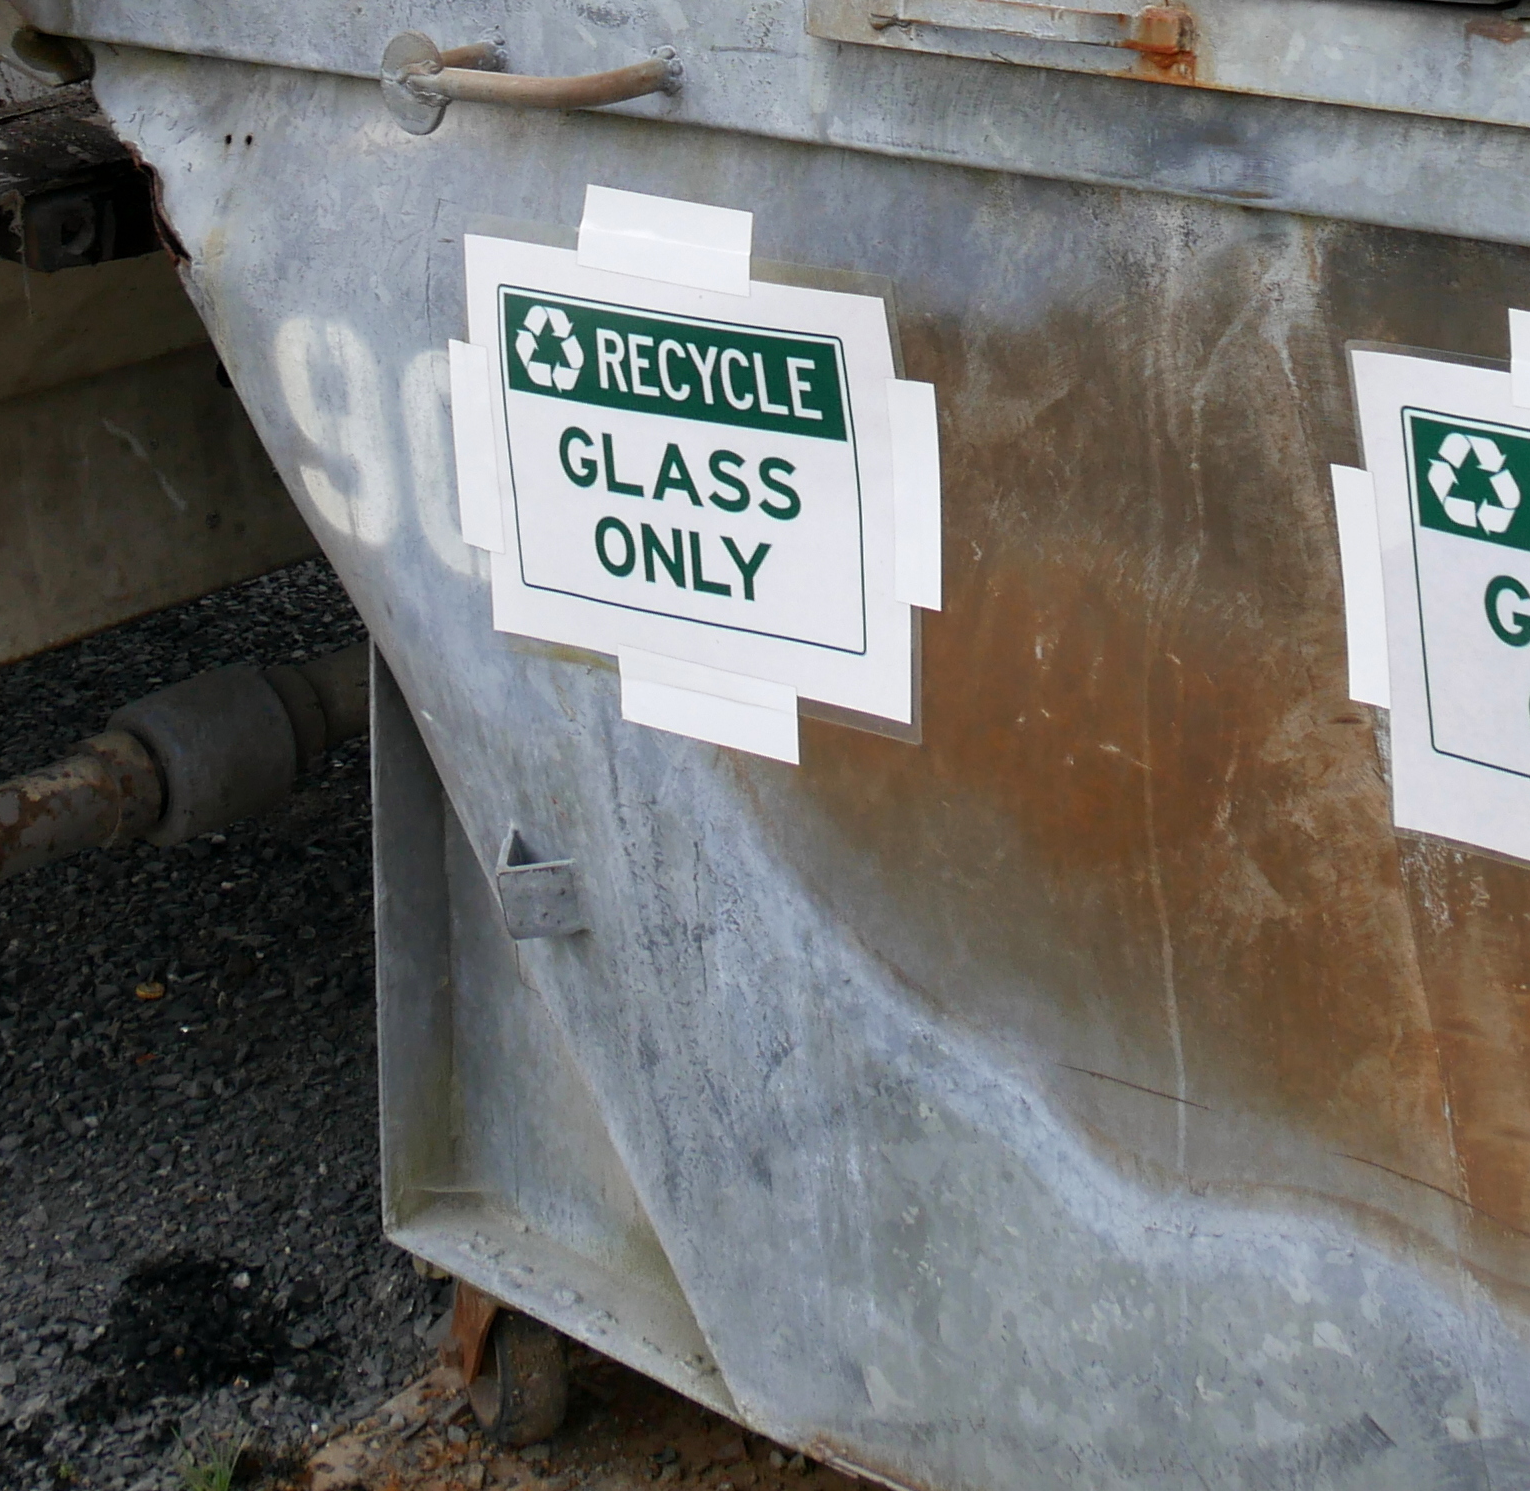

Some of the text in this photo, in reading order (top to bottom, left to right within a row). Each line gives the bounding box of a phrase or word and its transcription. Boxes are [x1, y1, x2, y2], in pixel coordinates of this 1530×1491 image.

[597, 327, 824, 421] RECYCLE
[558, 425, 803, 522] GLASS
[594, 515, 772, 602] ONLY
